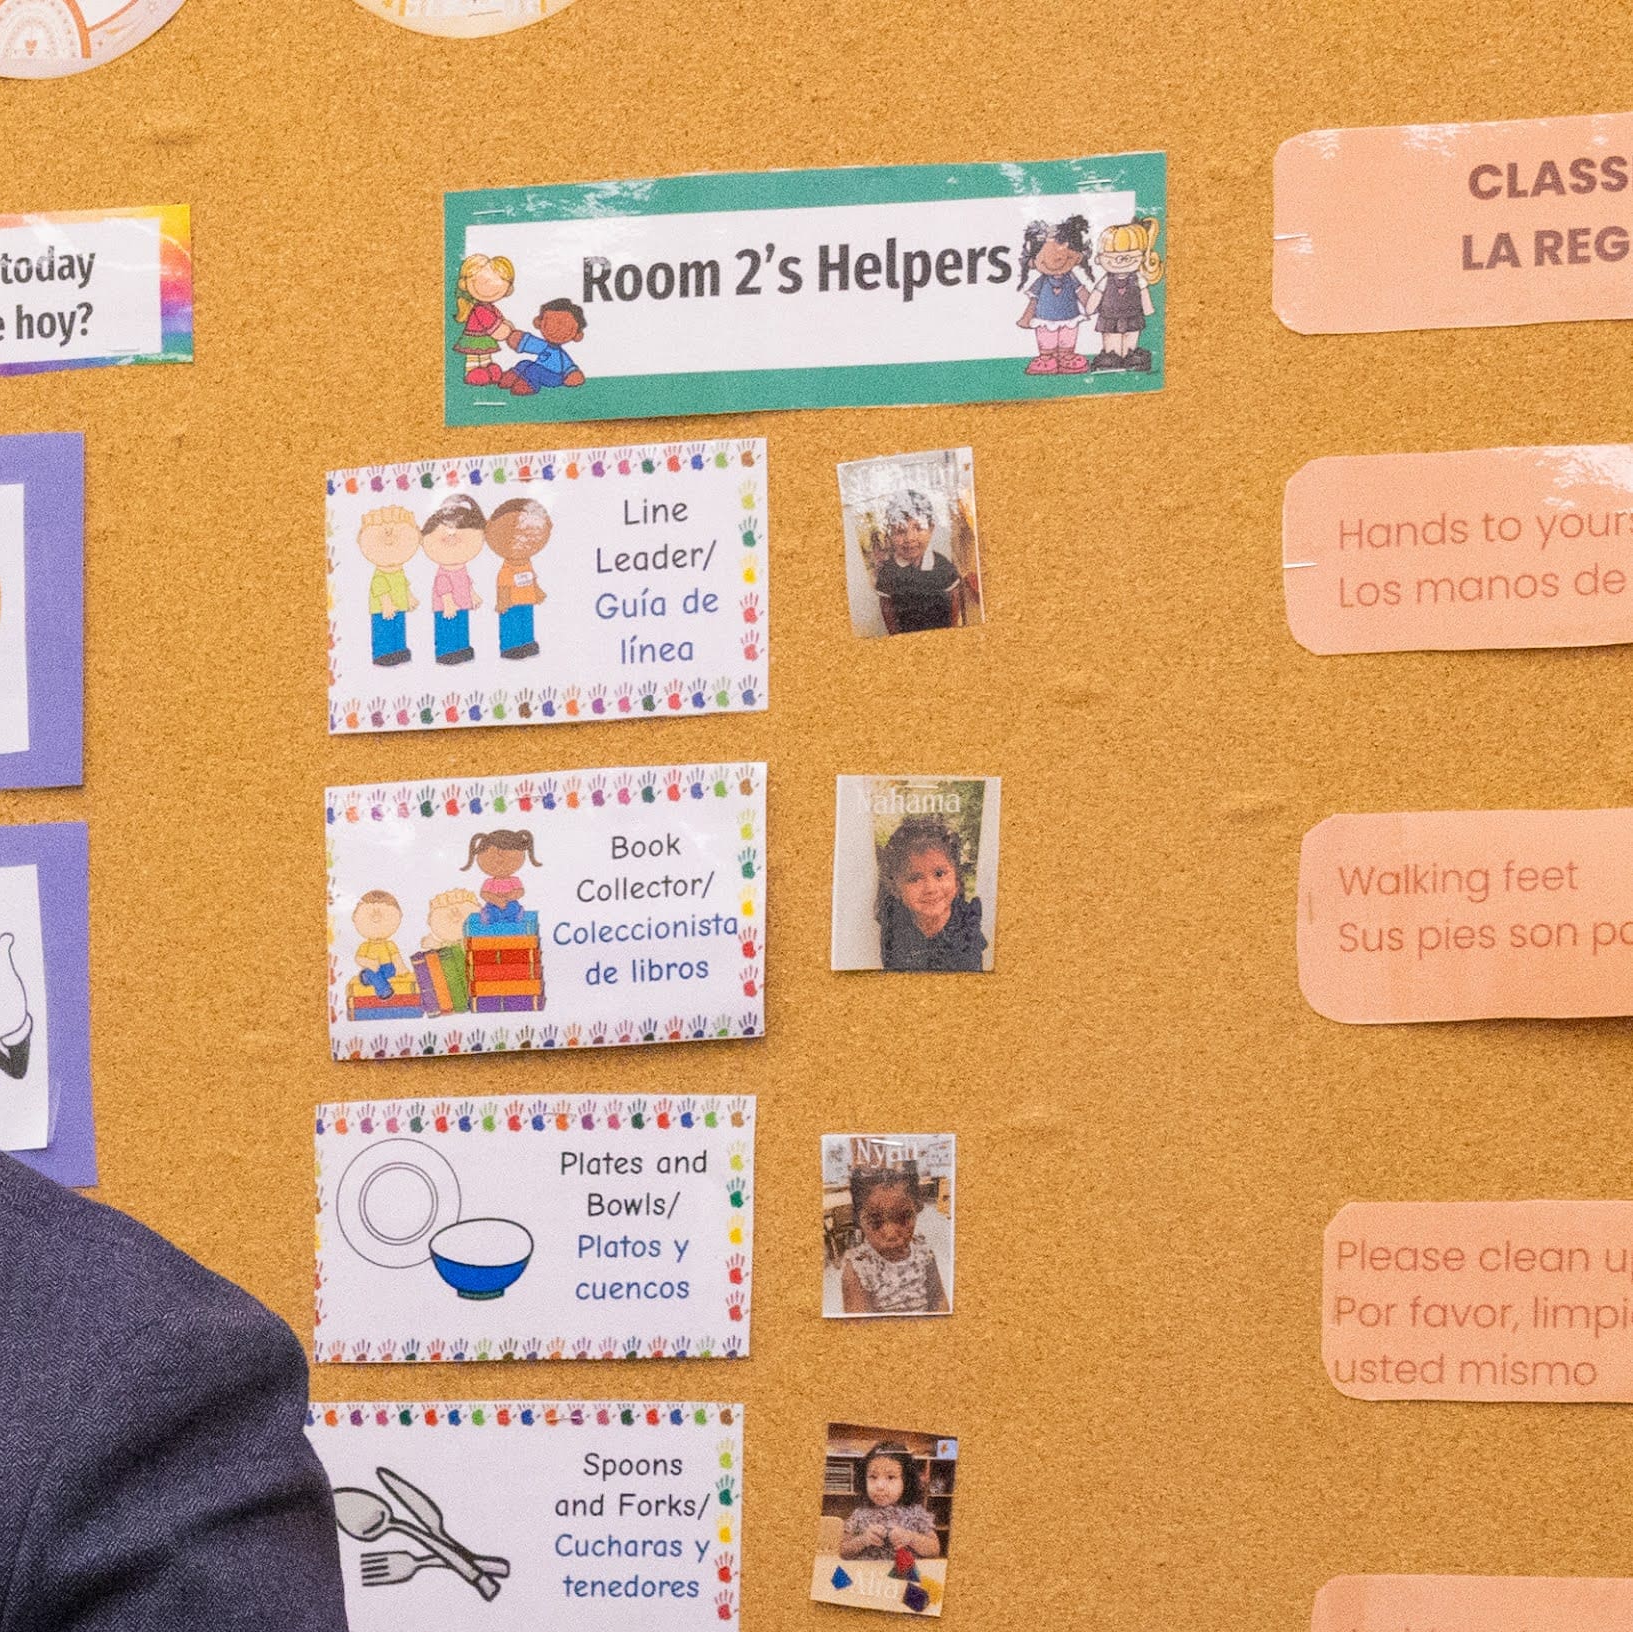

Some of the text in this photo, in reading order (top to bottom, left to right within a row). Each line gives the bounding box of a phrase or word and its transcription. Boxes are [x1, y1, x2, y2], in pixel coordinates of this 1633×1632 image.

[1468, 155, 1633, 201] CLASS
[1461, 225, 1629, 272] LA REG
[0, 245, 96, 290] today
[582, 238, 1012, 304] Room 2's Helpers
[15, 301, 94, 342] hoy?
[624, 499, 688, 526] Line
[1339, 508, 1633, 552] Hands to your
[596, 540, 717, 574] Leader/
[1338, 560, 1625, 609] Los manos de
[595, 589, 719, 619] Guía de
[620, 636, 694, 664] línea
[611, 833, 682, 859] Book
[576, 871, 715, 903] Collector/
[1339, 860, 1578, 902] Walking feet
[553, 914, 738, 945] Coleccionista
[1339, 922, 1404, 951] Sus
[1418, 919, 1496, 960] pies
[1510, 921, 1577, 949] son
[585, 955, 709, 985] de libros
[561, 1150, 708, 1176] Plates and
[587, 1191, 681, 1219] Bowls/
[577, 1234, 690, 1261] Platos y
[1337, 1240, 1633, 1283] Please clean u
[575, 1278, 690, 1301] cuencos
[1335, 1295, 1633, 1338] Por favor, limpi
[1335, 1354, 1597, 1385] usted mismo
[583, 1452, 683, 1481] Spoons
[555, 1492, 711, 1520] and Forks/
[555, 1533, 710, 1563] Cucharas y
[563, 1573, 699, 1599] tenedores
